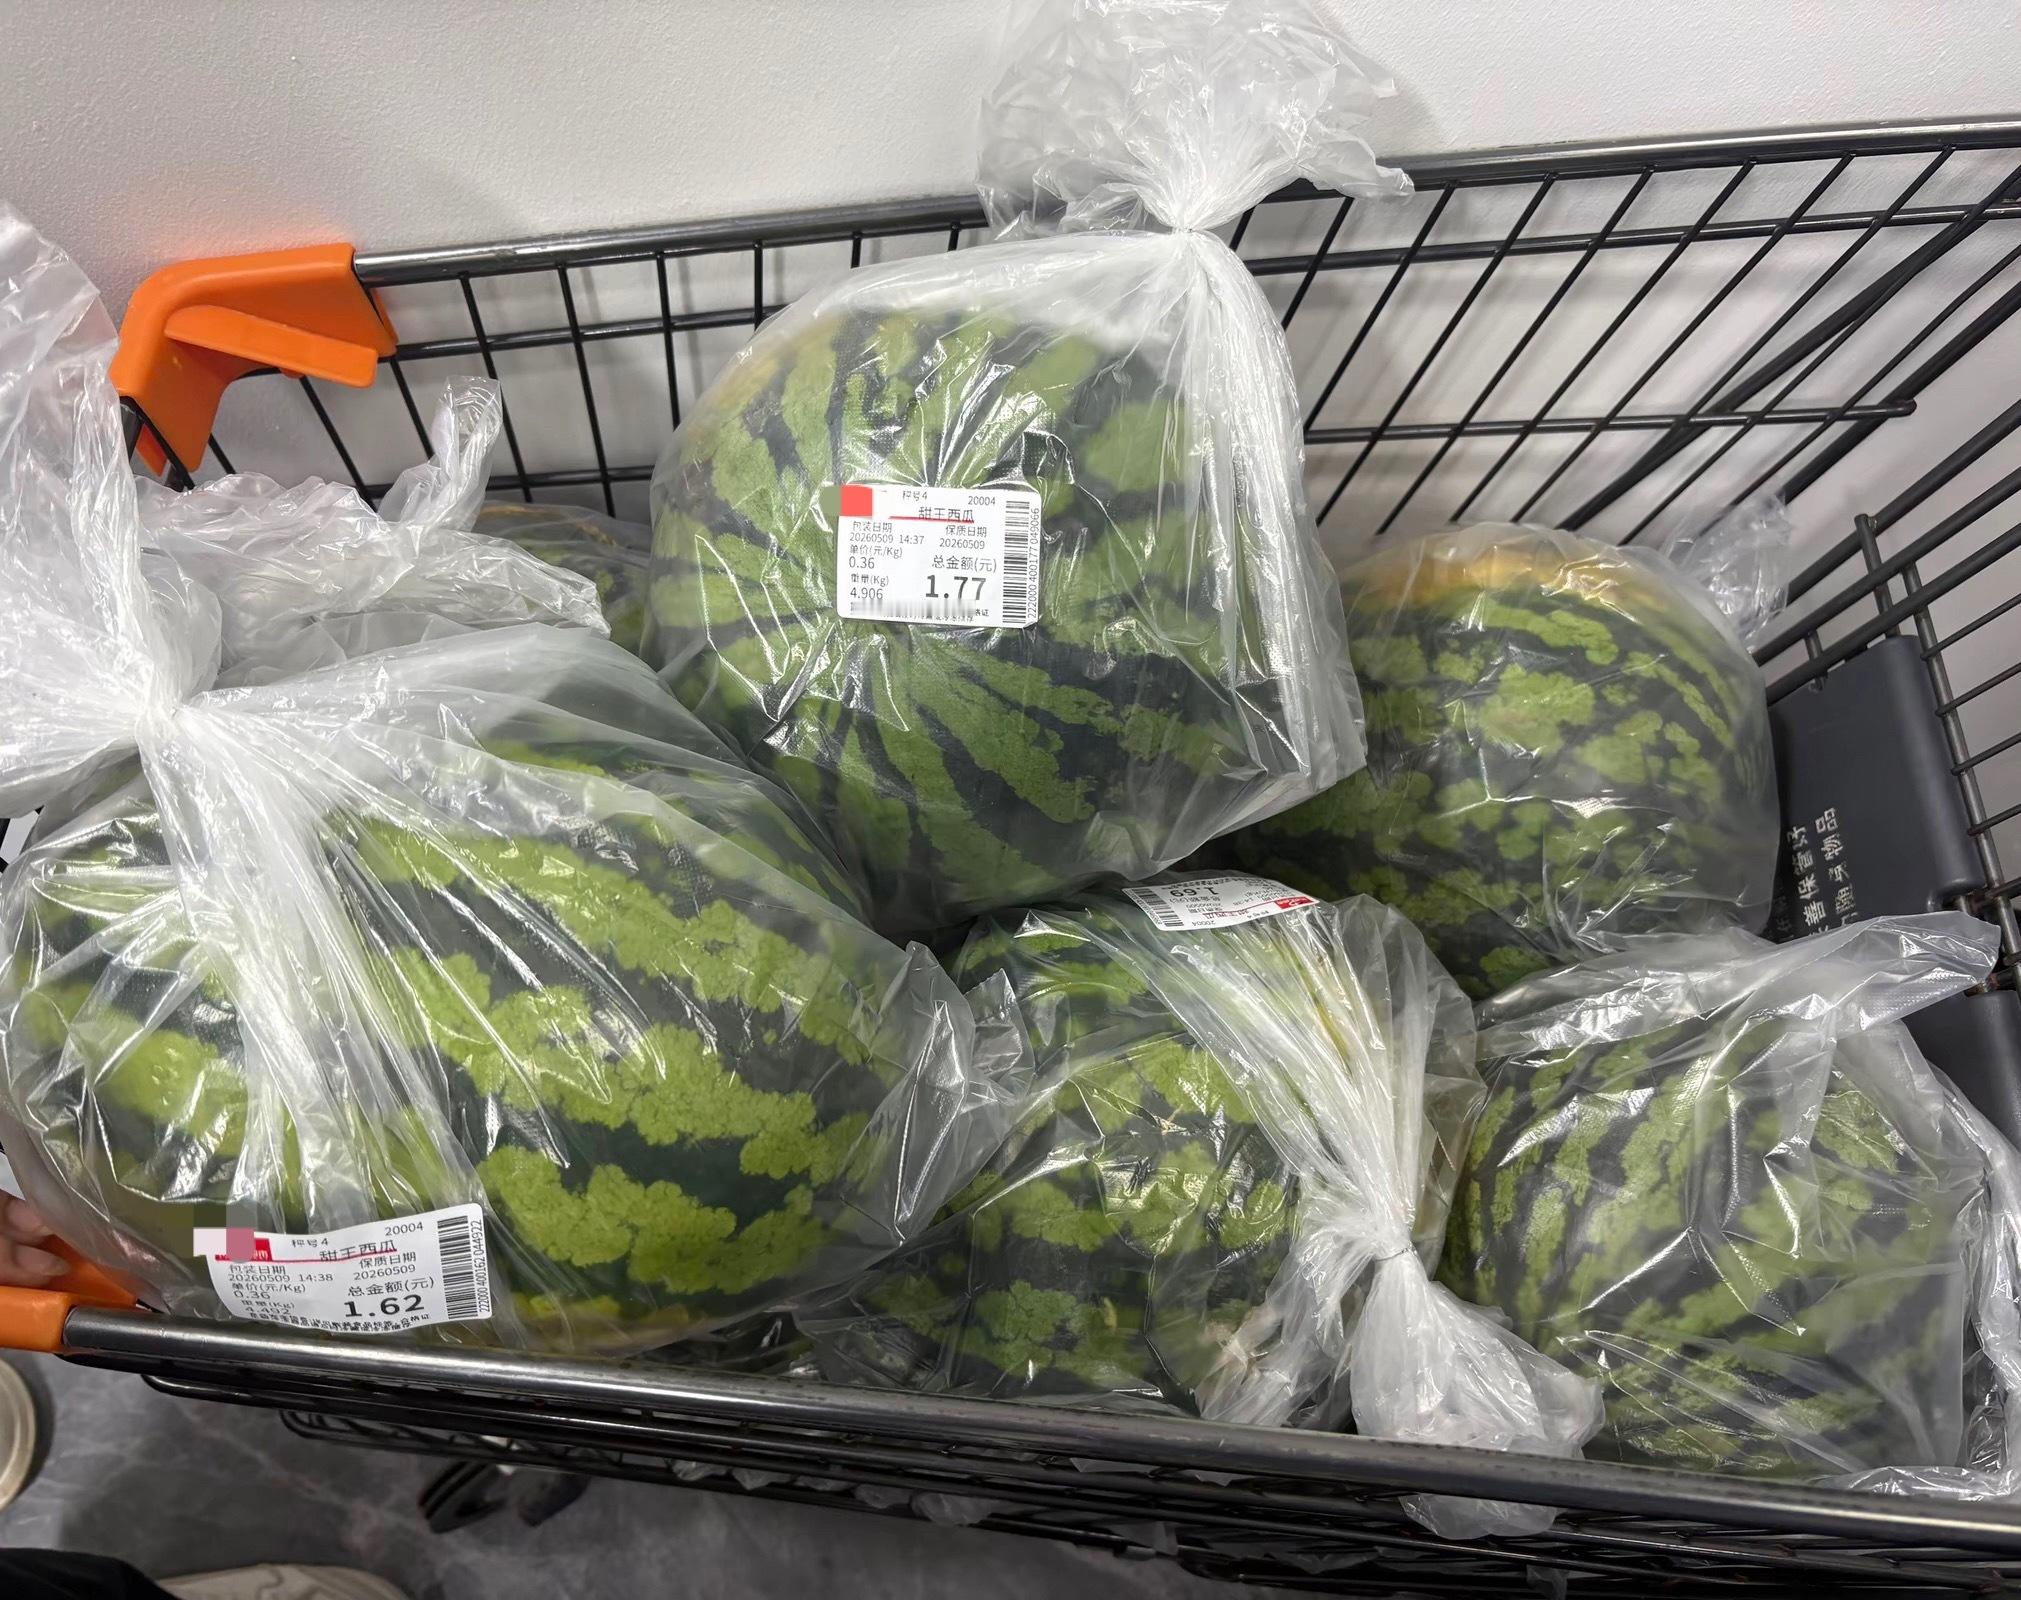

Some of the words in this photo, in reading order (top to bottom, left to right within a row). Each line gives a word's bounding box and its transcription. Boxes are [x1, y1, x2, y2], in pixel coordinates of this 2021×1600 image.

[968, 495, 996, 506] 20004
[918, 507, 975, 523] 甜王西瓜
[852, 521, 893, 534] 包装日期
[945, 525, 987, 537] 保质日期
[1030, 508, 1040, 544] 049066
[850, 534, 893, 543] 20260509
[899, 535, 925, 545] 14:37
[939, 538, 985, 549] 20260509
[850, 545, 903, 558] 单价(元/Kg)
[849, 556, 875, 569] 0.36
[932, 555, 997, 573] 总金额(元)
[1029, 546, 1038, 582] 400177
[850, 587, 883, 600] 4.906
[925, 574, 986, 600] 1.77
[1027, 585, 1037, 619] 222000
[1170, 887, 1219, 897] 1.69
[385, 1221, 424, 1236] 20004
[471, 1220, 484, 1255] 044922
[319, 1239, 397, 1261] 甜王西瓜
[359, 1252, 417, 1268] 保质日期
[228, 1273, 291, 1283] 20260509
[298, 1272, 333, 1283] 14:38
[354, 1264, 416, 1280] 20260509
[474, 1257, 487, 1286] 400162
[234, 1290, 271, 1300] 0.36
[348, 1277, 435, 1297] 总金额(元)
[344, 1294, 425, 1318] 1.62
[478, 1288, 490, 1312] 222000
